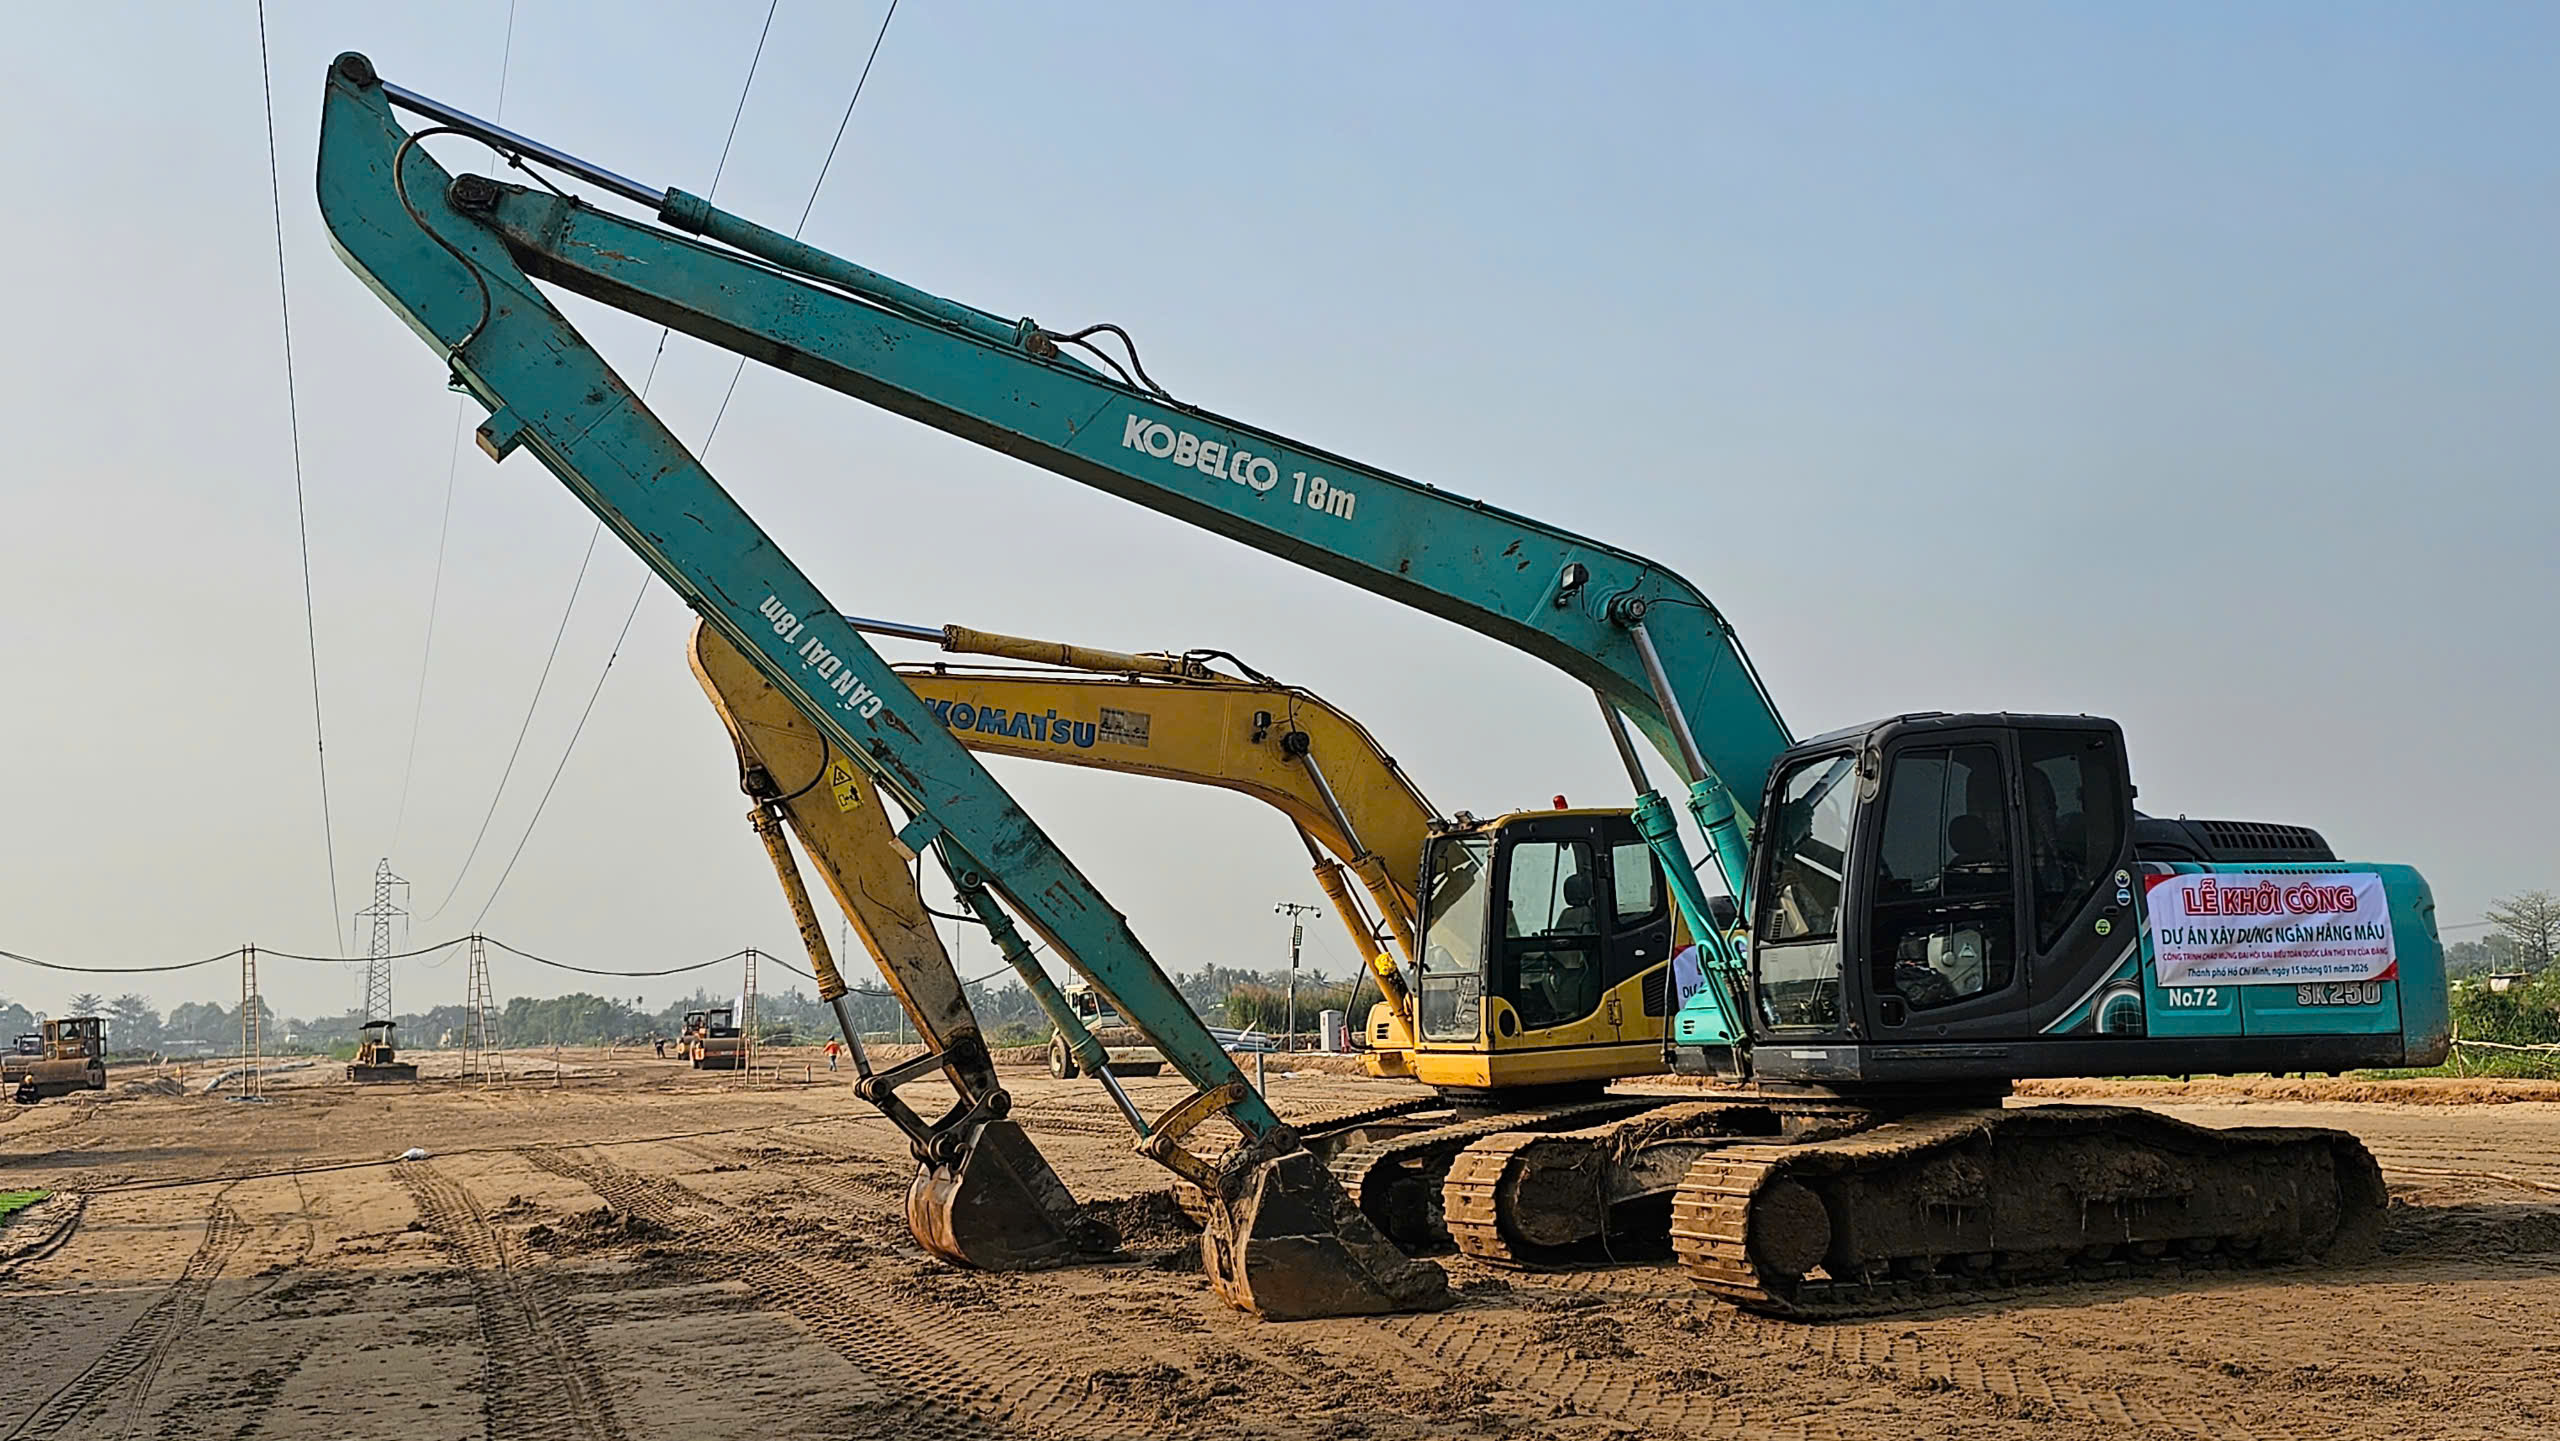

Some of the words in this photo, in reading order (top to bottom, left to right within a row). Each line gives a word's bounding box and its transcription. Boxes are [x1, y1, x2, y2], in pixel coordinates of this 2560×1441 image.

[1122, 414, 1279, 491] KOBELCO
[1293, 472, 1356, 520] 18m
[759, 595, 804, 644] 18m
[799, 636, 842, 680] DÀI
[925, 698, 1096, 748] KOMATSU
[2182, 878, 2220, 915] LỄ
[2221, 880, 2284, 915] KHỞI
[2283, 882, 2357, 914] CÔNG
[2161, 926, 2184, 949] DỰ
[2188, 925, 2208, 945] ÁN
[2210, 925, 2235, 945] XÂY
[2237, 925, 2273, 948] DỰNG
[2275, 924, 2313, 943] NGÂN
[2316, 922, 2352, 941] HÀNG
[2354, 921, 2385, 940] MÁU
[2291, 966, 2300, 975] 15
[2323, 964, 2332, 974] 01
[2350, 963, 2369, 973] 2026
[2297, 982, 2382, 1006] SK250
